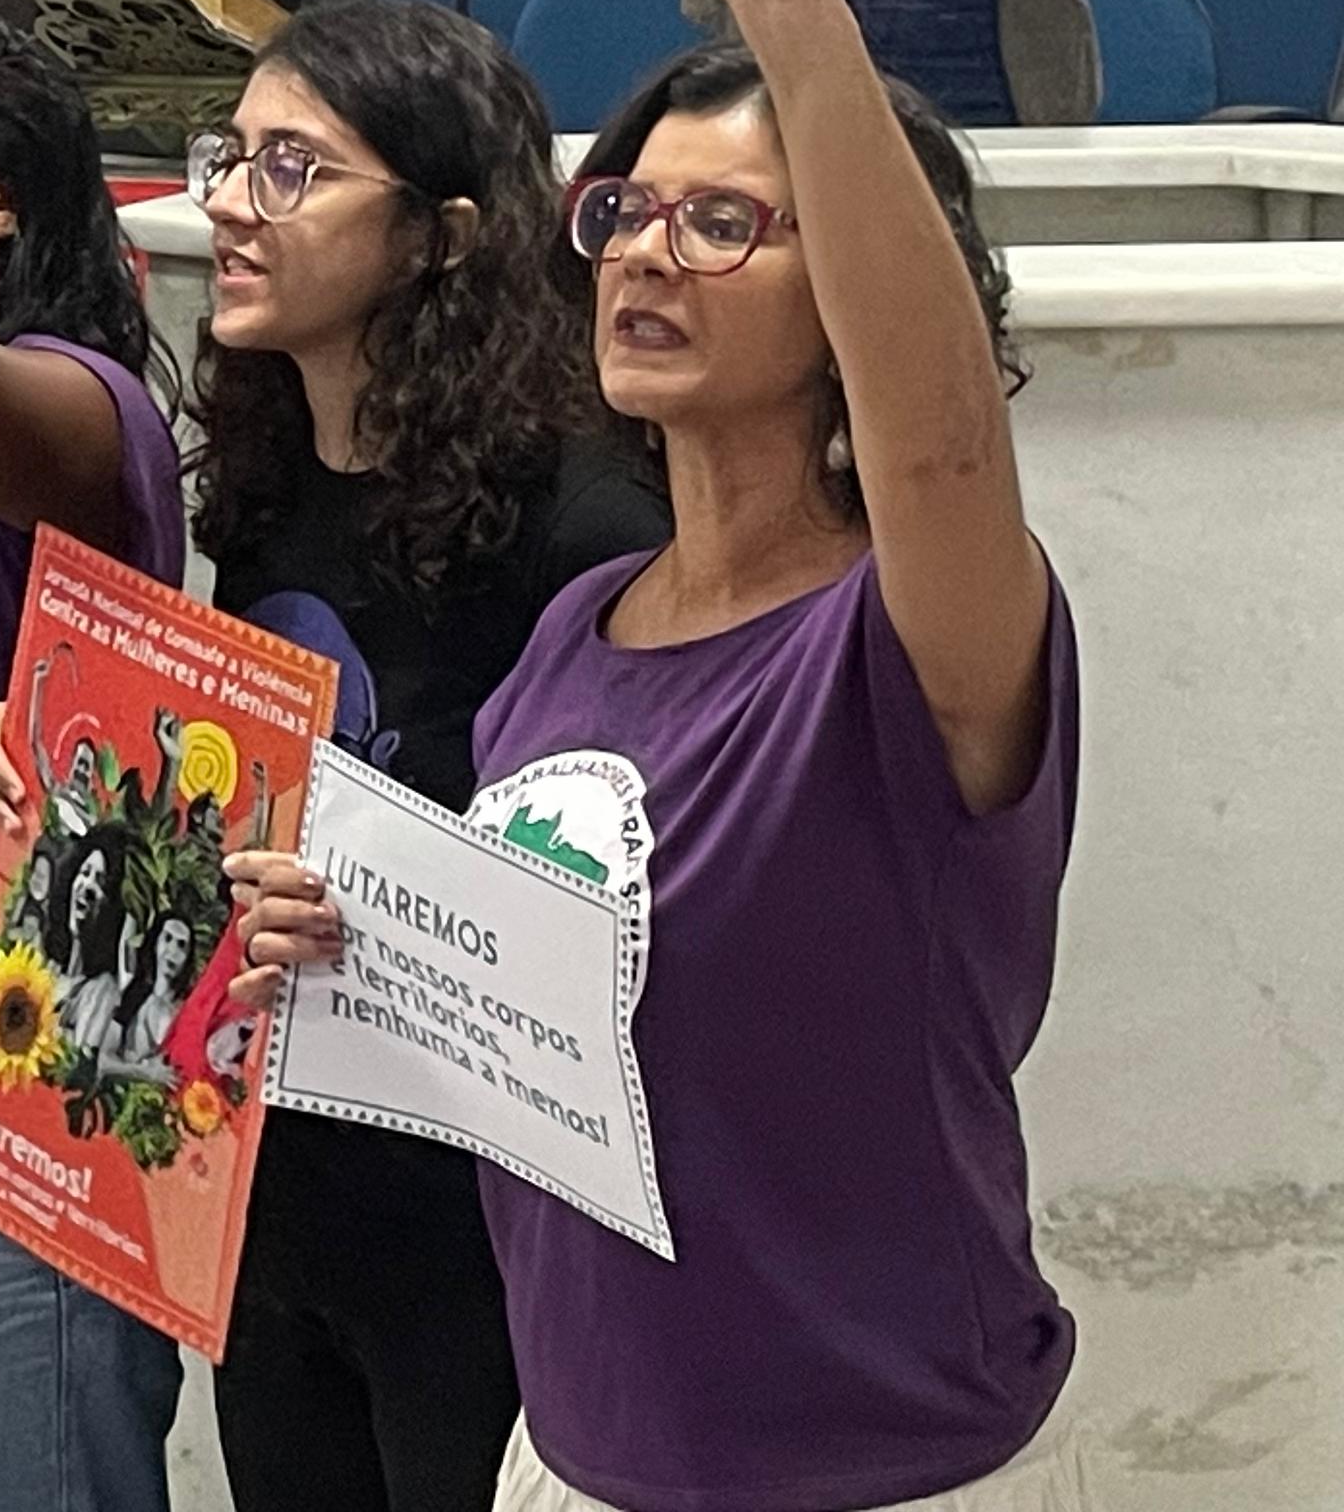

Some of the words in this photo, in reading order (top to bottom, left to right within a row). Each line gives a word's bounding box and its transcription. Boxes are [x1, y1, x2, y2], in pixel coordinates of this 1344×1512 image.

[39, 588, 88, 634] Contra
[111, 624, 198, 689] Mulheres
[201, 672, 217, 696] e
[219, 675, 311, 737] Meninas
[324, 845, 499, 966] LUTAREMOS
[337, 919, 366, 953] or
[374, 935, 475, 1009] nossos
[480, 993, 583, 1063] corpos
[330, 988, 475, 1074] nenhuma
[480, 1059, 498, 1087] a
[501, 1069, 611, 1148] menos!
